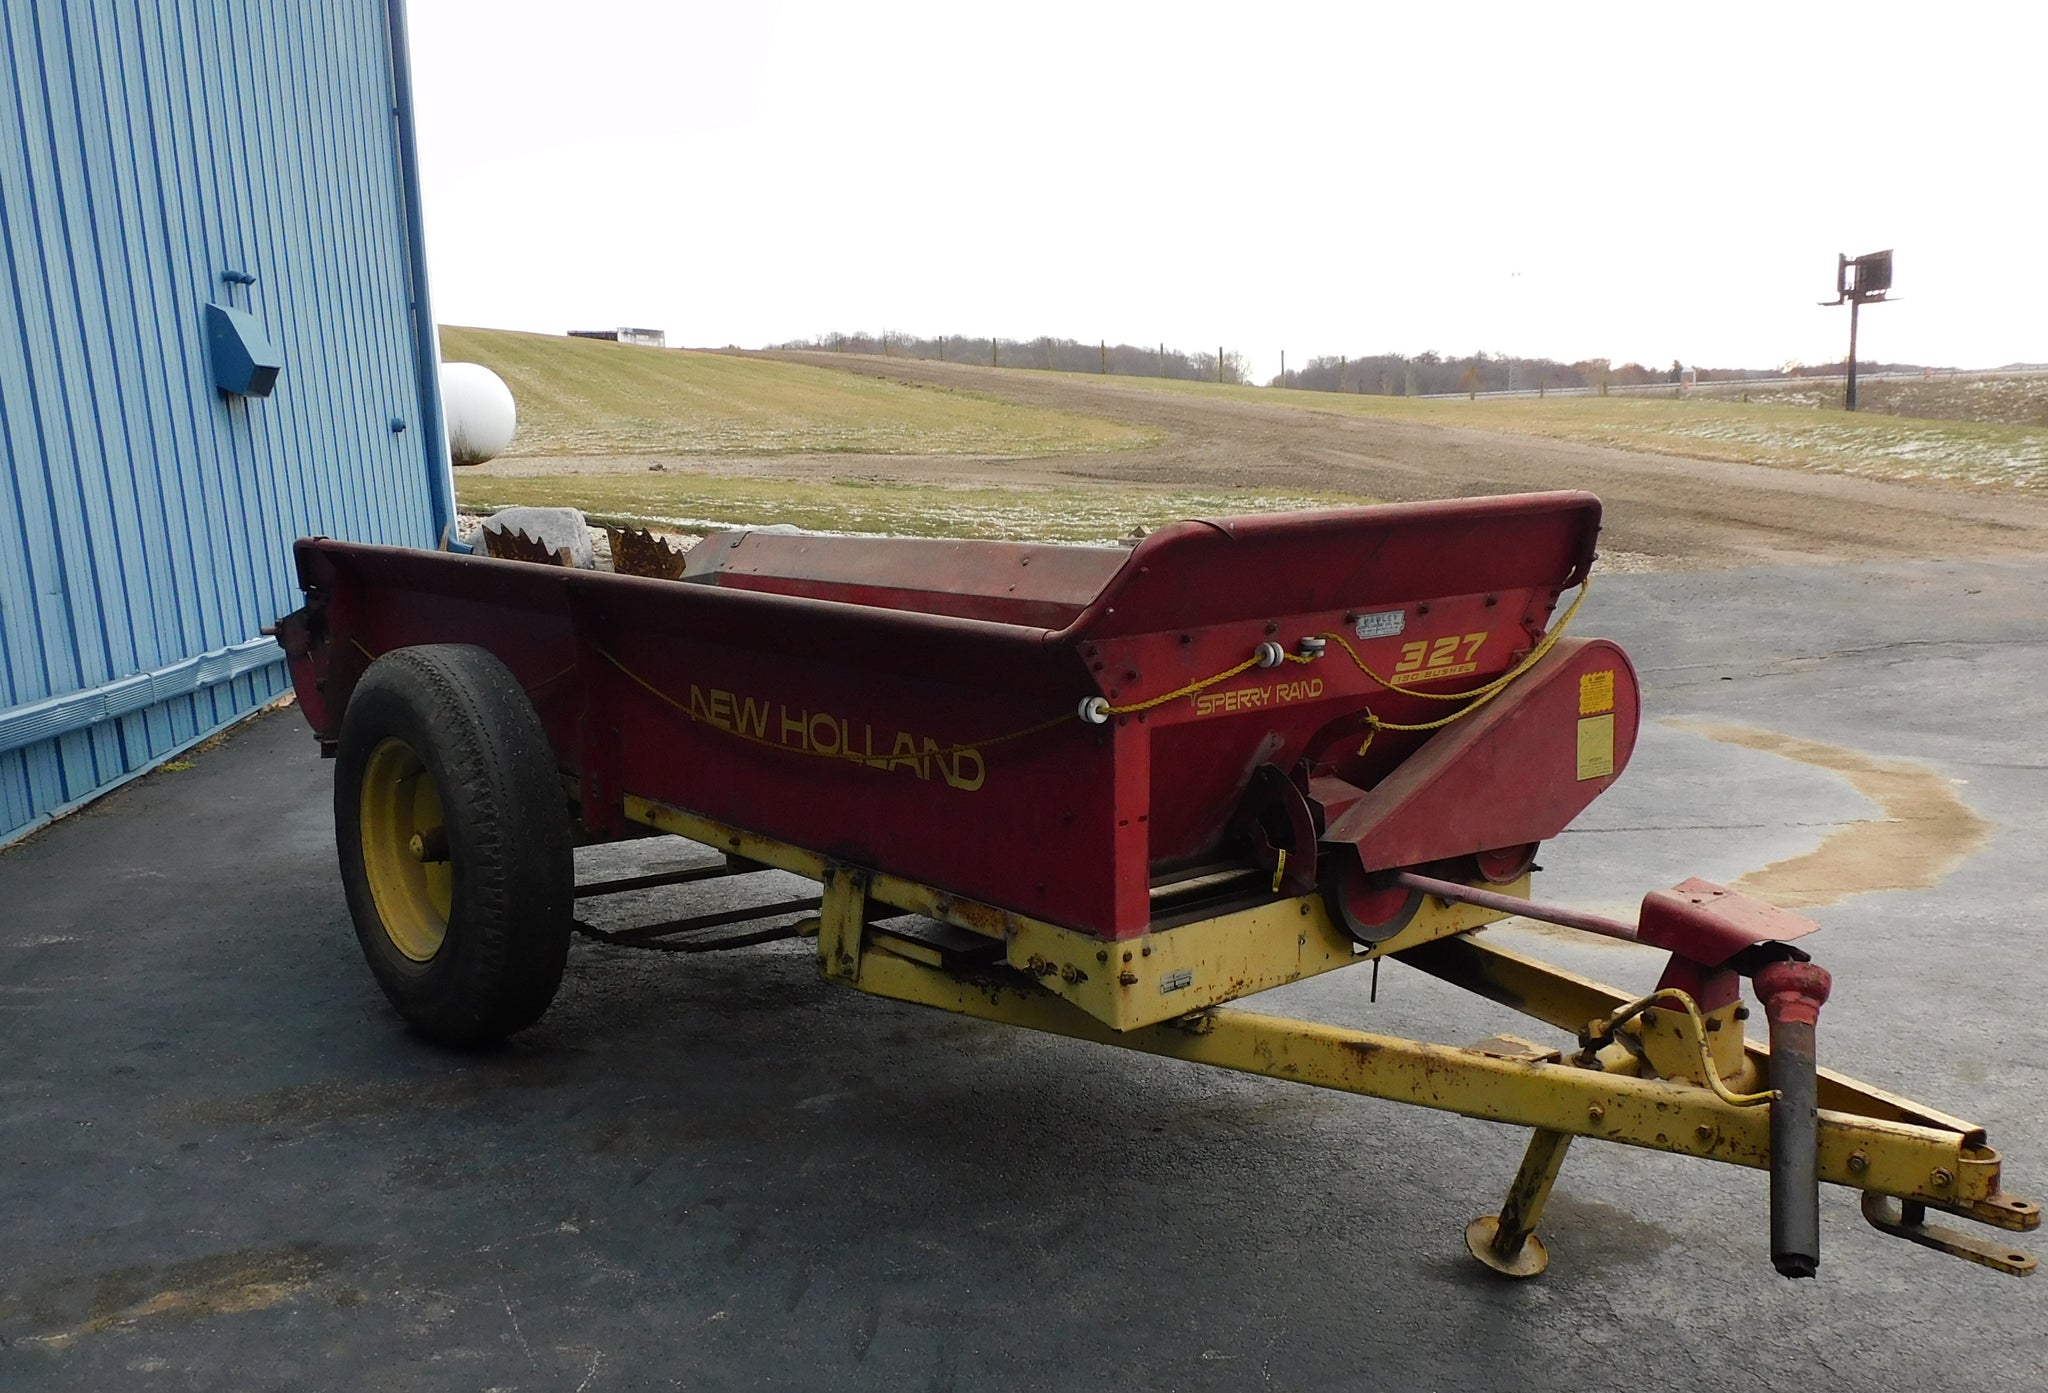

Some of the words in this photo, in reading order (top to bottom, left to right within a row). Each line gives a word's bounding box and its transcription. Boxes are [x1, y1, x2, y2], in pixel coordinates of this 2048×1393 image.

[1395, 631, 1488, 672] 327
[1424, 665, 1471, 678] BUSHEL
[1196, 685, 1272, 716] SPERRY
[1276, 678, 1323, 703] RAND
[690, 684, 770, 739] NEW
[780, 704, 986, 791] HOLLAND
